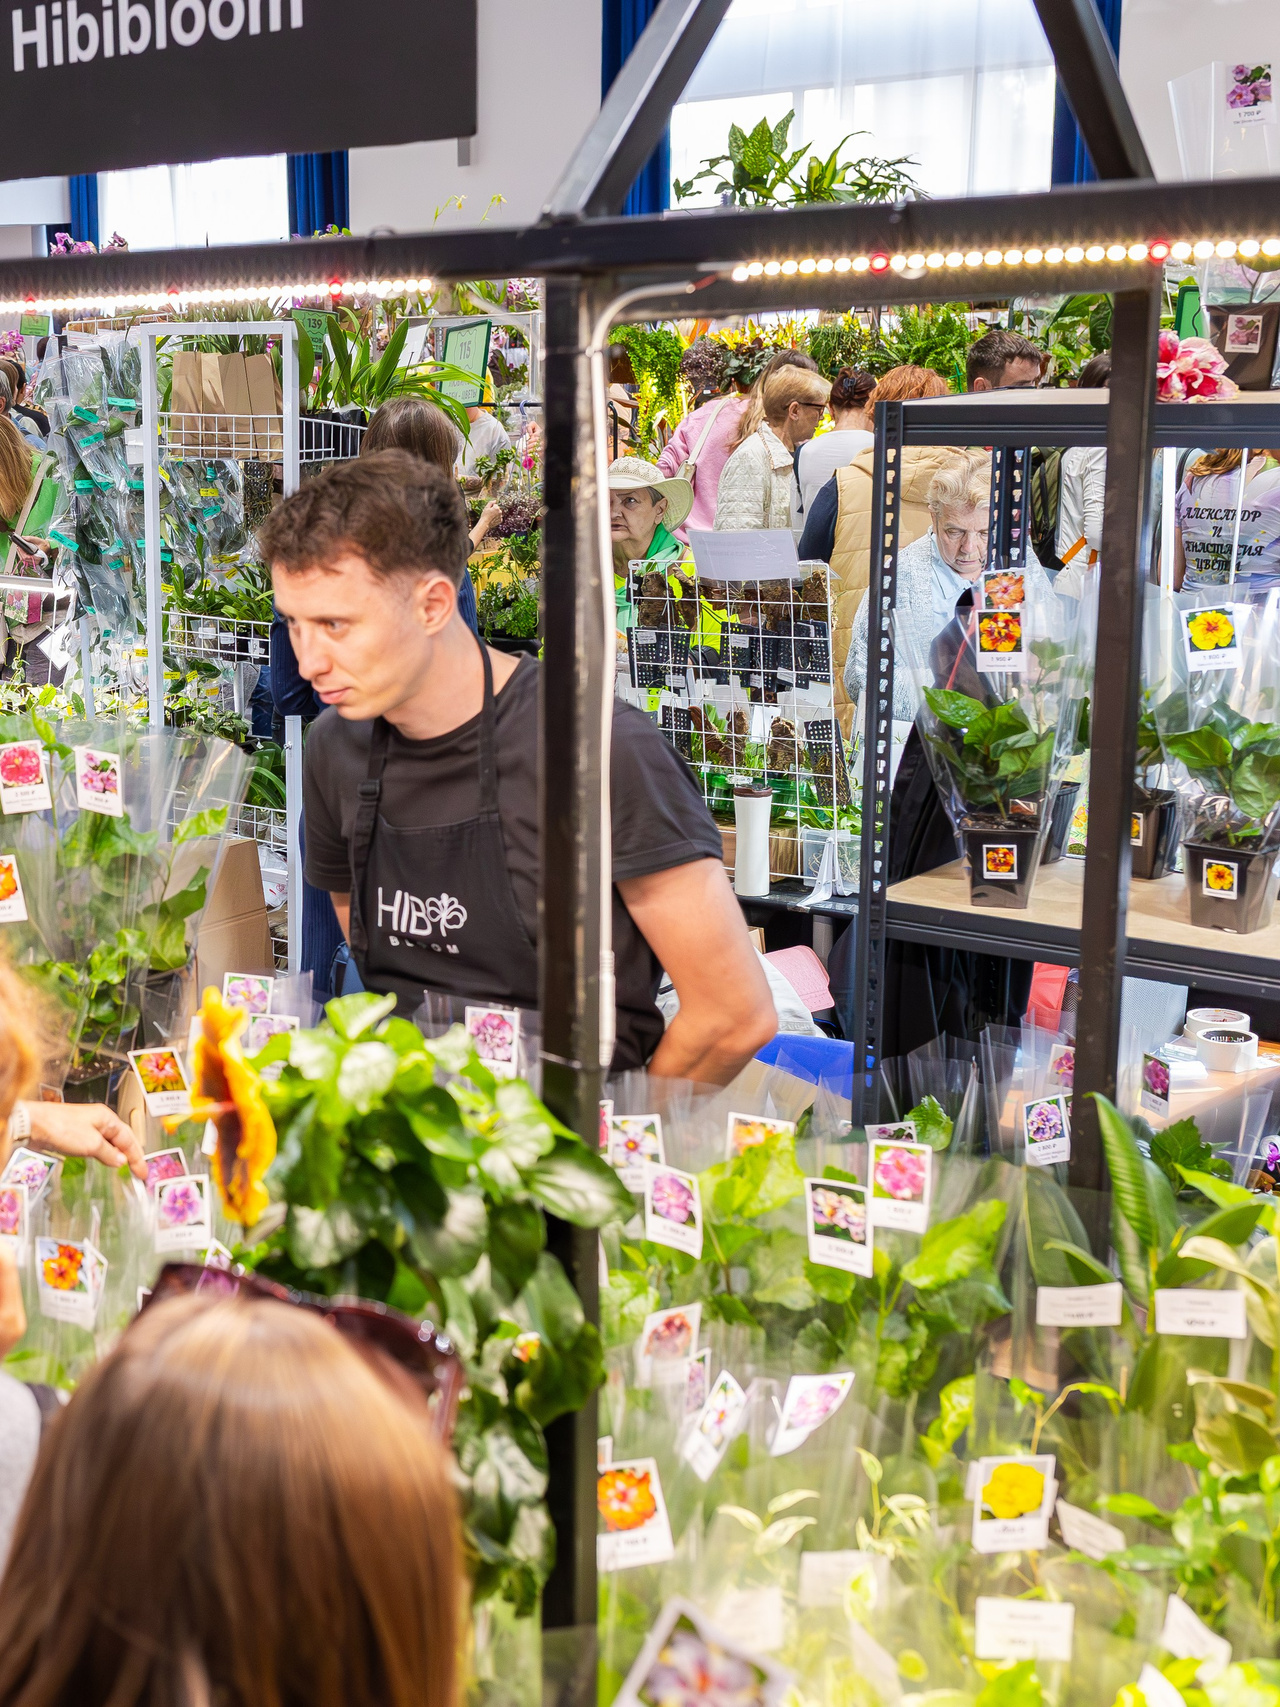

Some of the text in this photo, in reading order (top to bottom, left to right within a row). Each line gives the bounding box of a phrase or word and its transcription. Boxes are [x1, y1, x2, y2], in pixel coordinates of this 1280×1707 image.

[12, 0, 304, 72] Hibibloom
[307, 318, 322, 329] 139
[460, 341, 472, 360] 115
[1182, 507, 1262, 522] АЛЕКСАНДР
[1212, 525, 1222, 538] И
[1185, 541, 1265, 557] АНАСТАСИЯ
[388, 935, 460, 954] BLOM
